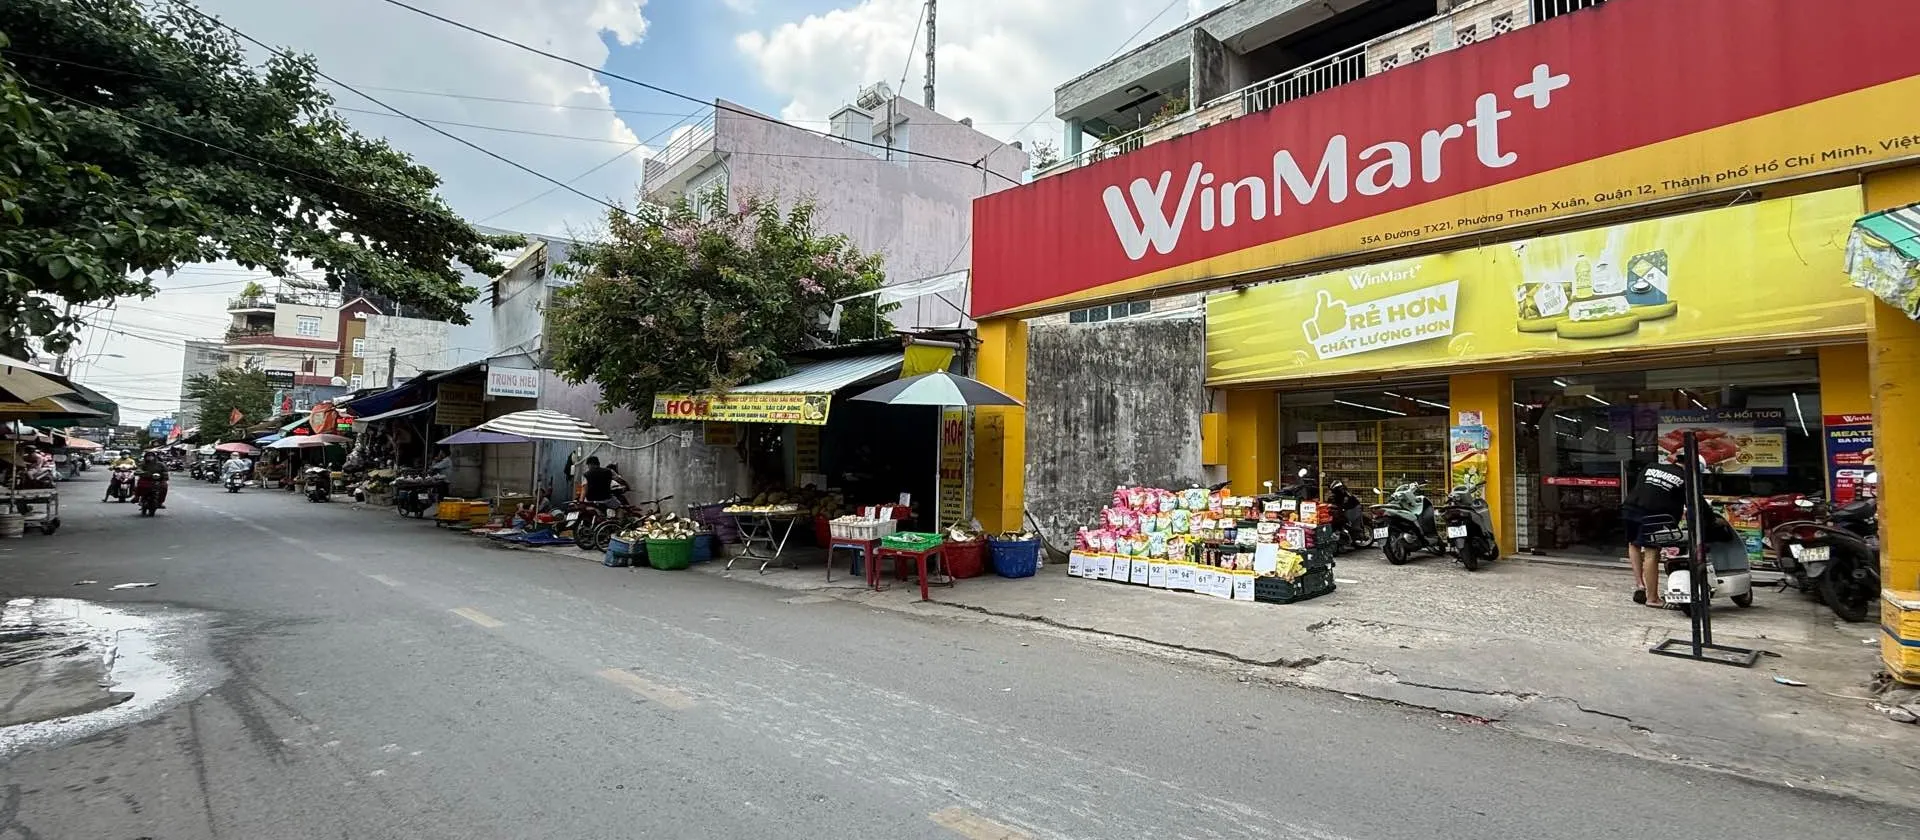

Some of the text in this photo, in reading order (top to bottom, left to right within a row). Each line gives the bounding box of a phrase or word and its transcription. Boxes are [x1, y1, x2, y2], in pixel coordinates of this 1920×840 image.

[1360, 134, 1920, 246] 35A Đường TX21, Phường Thạnh Xuân, Quận 12, Thành phố Hồ Chí Minh, Việt
[1350, 294, 1448, 331] RẺ HƠN
[1319, 319, 1451, 354] CHẤT LƯỢNG HƠN
[491, 373, 517, 386] TRUNG
